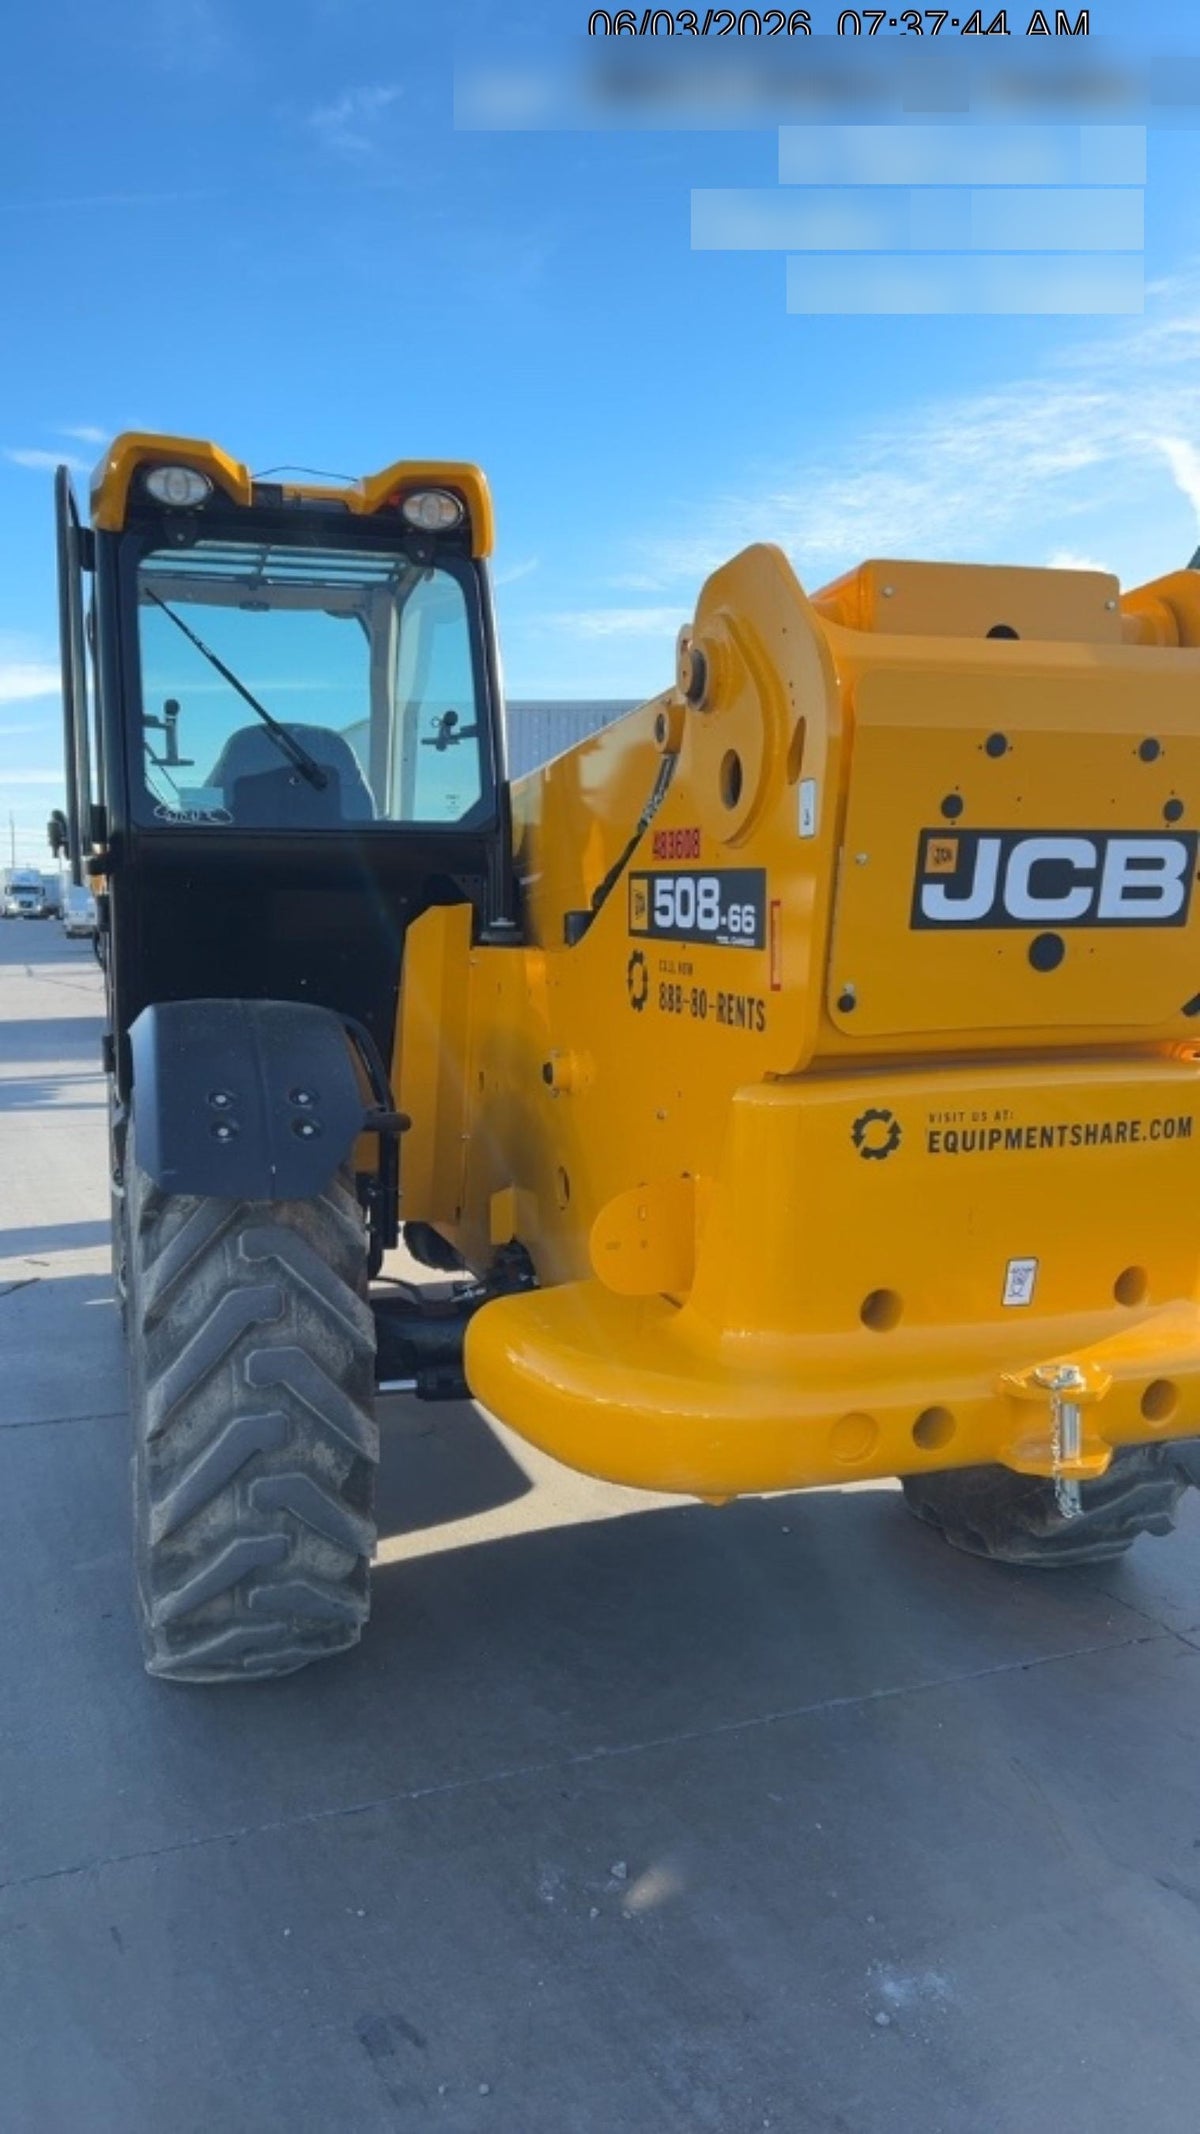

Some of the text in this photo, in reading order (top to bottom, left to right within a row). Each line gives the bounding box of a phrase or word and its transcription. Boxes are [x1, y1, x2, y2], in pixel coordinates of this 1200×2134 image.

[921, 837, 1188, 921] JCB
[928, 1116, 1193, 1154] EQUIPMENTSHARE.COM
[929, 1111, 965, 1123] VISIT
[971, 1111, 987, 1122] US
